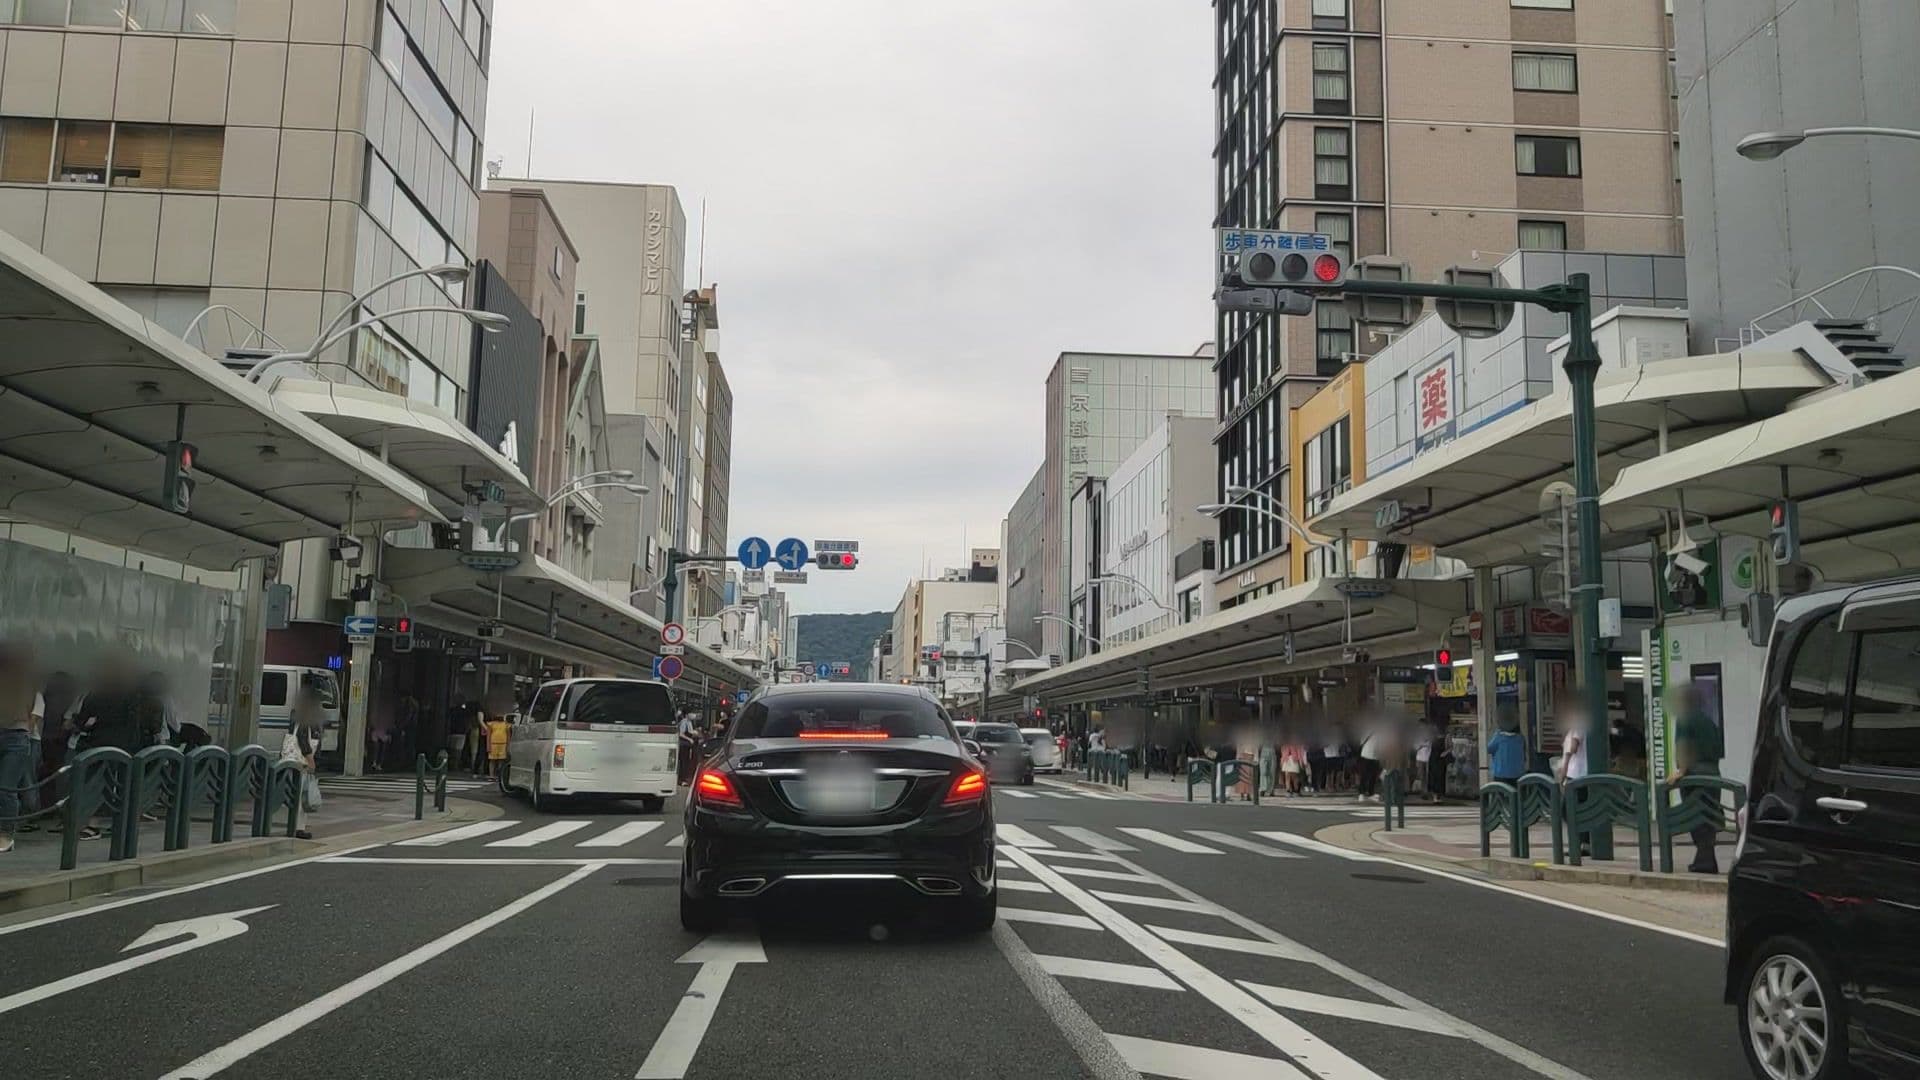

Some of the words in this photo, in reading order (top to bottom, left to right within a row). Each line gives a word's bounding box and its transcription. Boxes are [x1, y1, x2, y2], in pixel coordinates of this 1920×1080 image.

[643, 208, 661, 294] カワシマビル
[1225, 232, 1328, 251] 歩車分離信号
[1421, 368, 1447, 429] 薬
